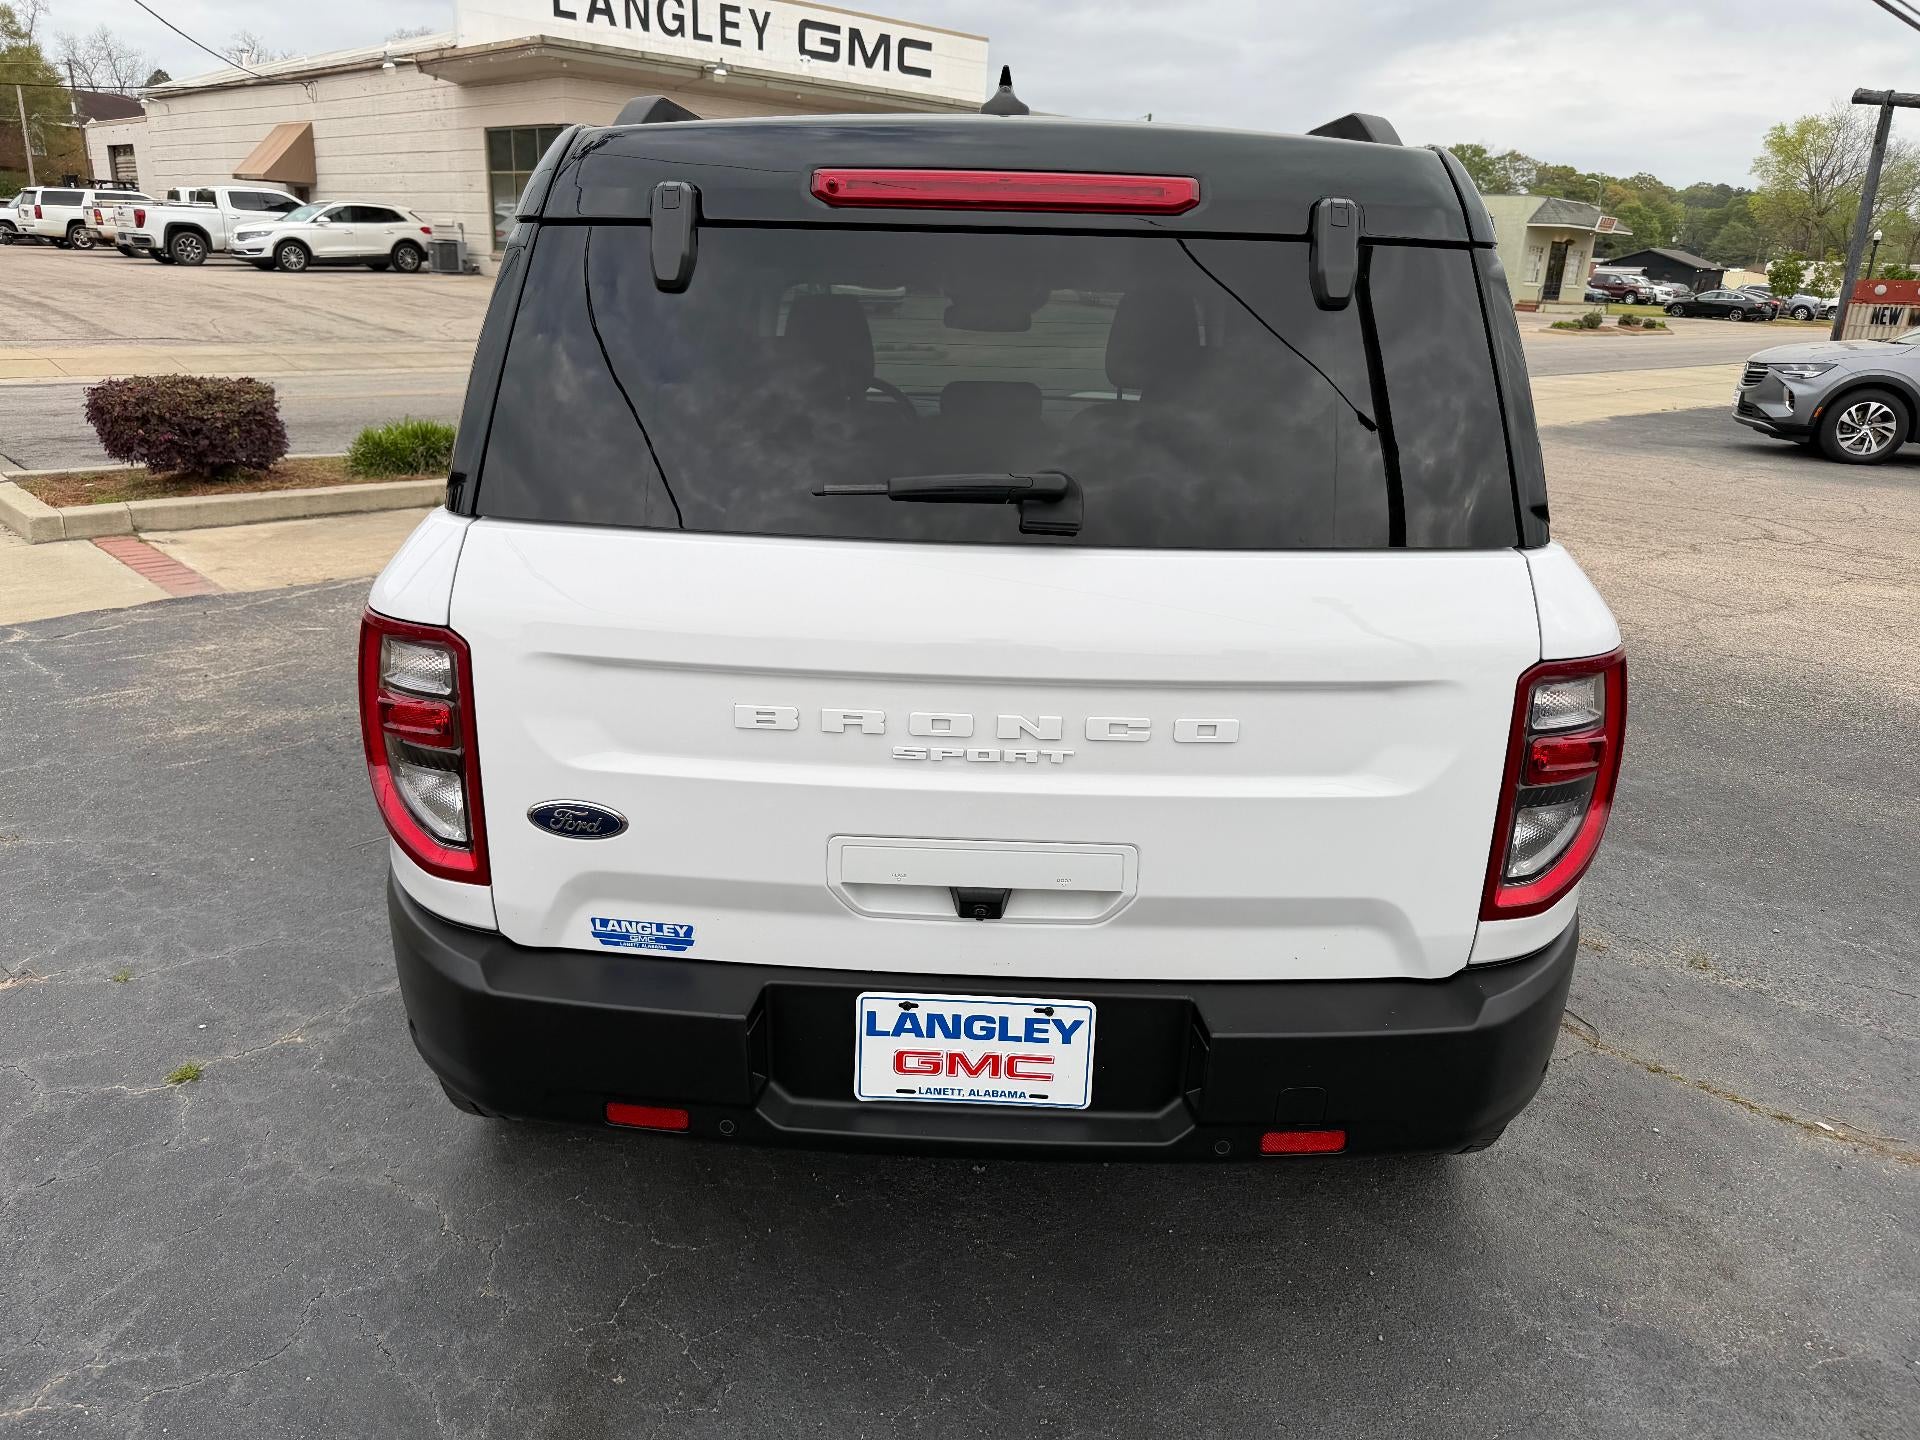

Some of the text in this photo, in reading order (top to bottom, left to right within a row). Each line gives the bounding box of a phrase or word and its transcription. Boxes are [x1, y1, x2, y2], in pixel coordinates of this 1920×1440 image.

[798, 18, 933, 78] GMC
[1871, 306, 1904, 325] NEW
[733, 703, 1241, 743] BRONCO
[891, 745, 1076, 764] SPORT
[550, 808, 602, 833] Ford
[595, 918, 688, 938] LANGLEY
[629, 934, 656, 943] GMC
[865, 1010, 1084, 1044] LANGLEY
[893, 1048, 1055, 1082] GMC
[918, 1086, 1027, 1099] LANETT, ALABAMA
